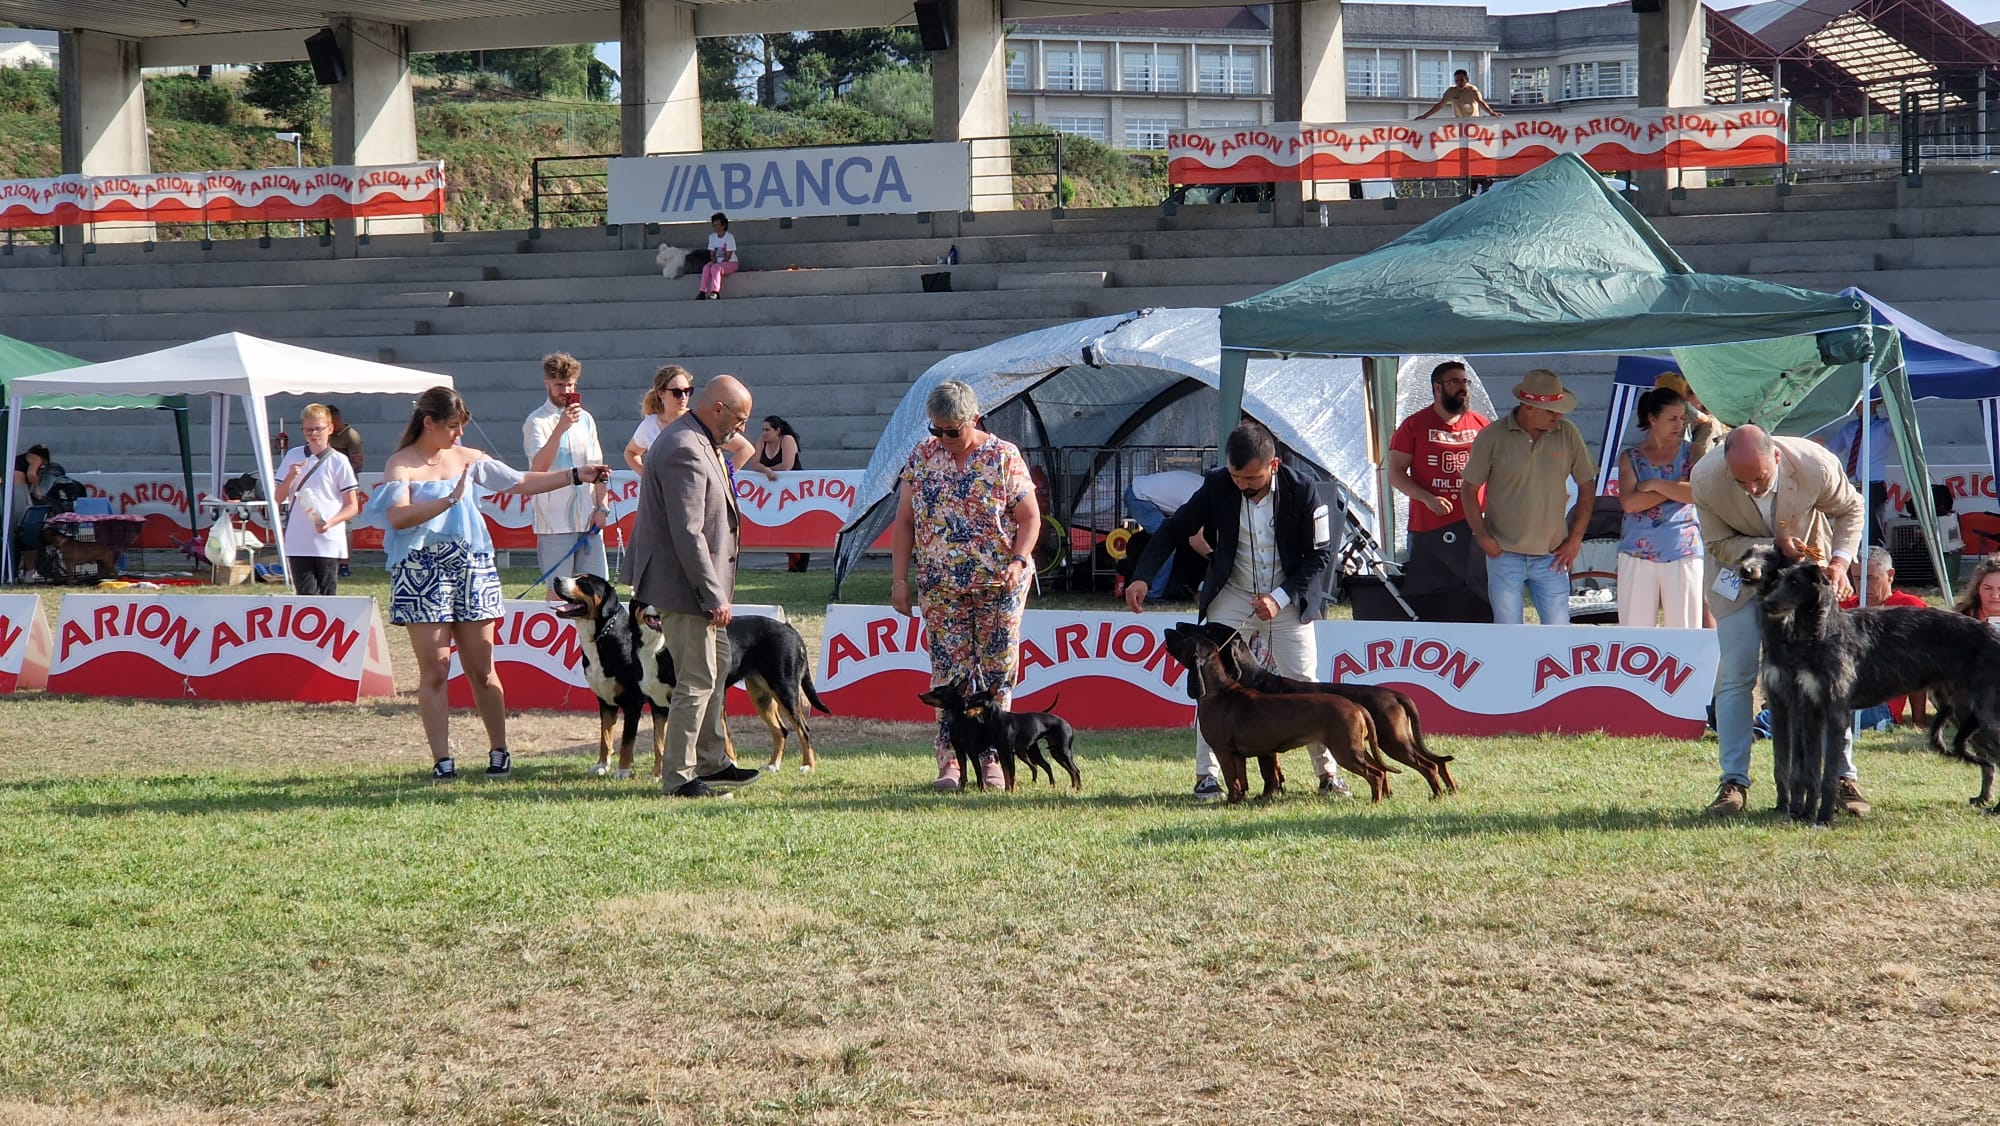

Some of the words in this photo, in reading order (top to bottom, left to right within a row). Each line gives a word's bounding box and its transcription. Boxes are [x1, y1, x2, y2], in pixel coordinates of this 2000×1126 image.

[1168, 132, 1217, 157] RION
[1221, 131, 1284, 158] ARION
[1288, 128, 1354, 157] ARION
[1358, 125, 1424, 153] ARION
[1429, 122, 1496, 151] ARION
[1500, 119, 1568, 148] ARION
[1574, 116, 1642, 145] ARION
[1647, 113, 1719, 142] ARION
[0, 184, 40, 204] RION
[43, 182, 88, 204] ARION
[93, 179, 140, 201] ARION
[145, 176, 193, 199] ARION
[197, 175, 247, 198] ARION
[250, 174, 301, 197] ARION
[304, 172, 354, 196] ARION
[358, 170, 411, 194] ARION
[1944, 474, 1999, 501] RIO
[60, 602, 201, 665] ARION
[209, 603, 361, 666] ARION
[494, 611, 583, 672] ION
[827, 616, 929, 681] ARI
[1016, 621, 1189, 689] ARION
[1330, 636, 1483, 692] ARION
[1531, 641, 1695, 698] ARION
